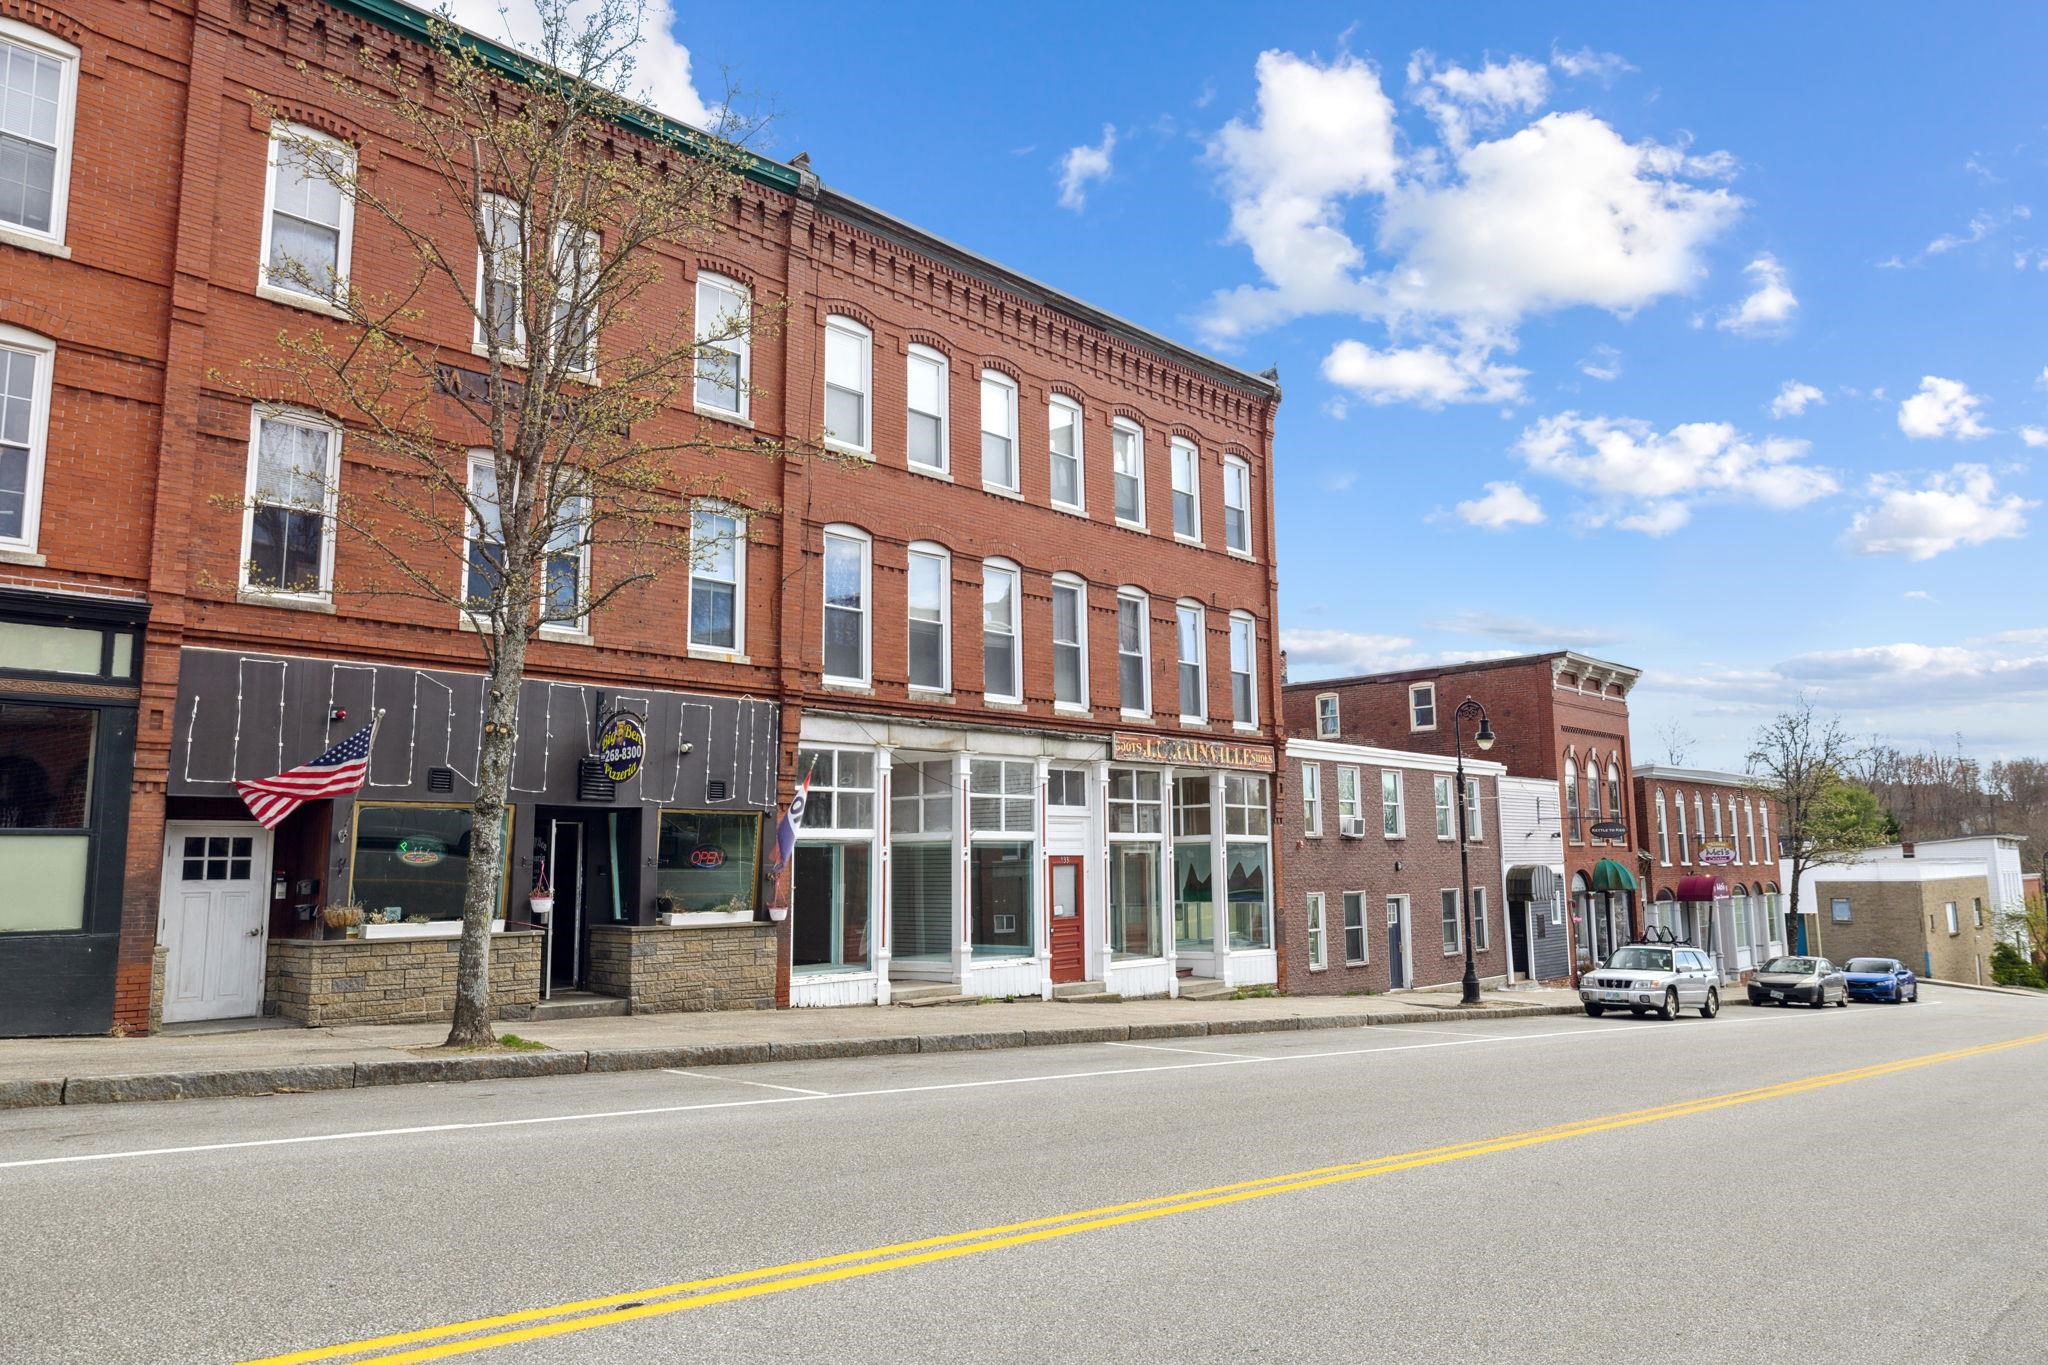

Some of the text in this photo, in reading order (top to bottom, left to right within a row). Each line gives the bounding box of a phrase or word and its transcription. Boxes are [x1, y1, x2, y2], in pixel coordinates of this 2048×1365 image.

[602, 724, 642, 751] Big Ben
[605, 745, 642, 762] 268-8300
[604, 761, 637, 781] Pizzeria
[691, 850, 724, 865] OPEN
